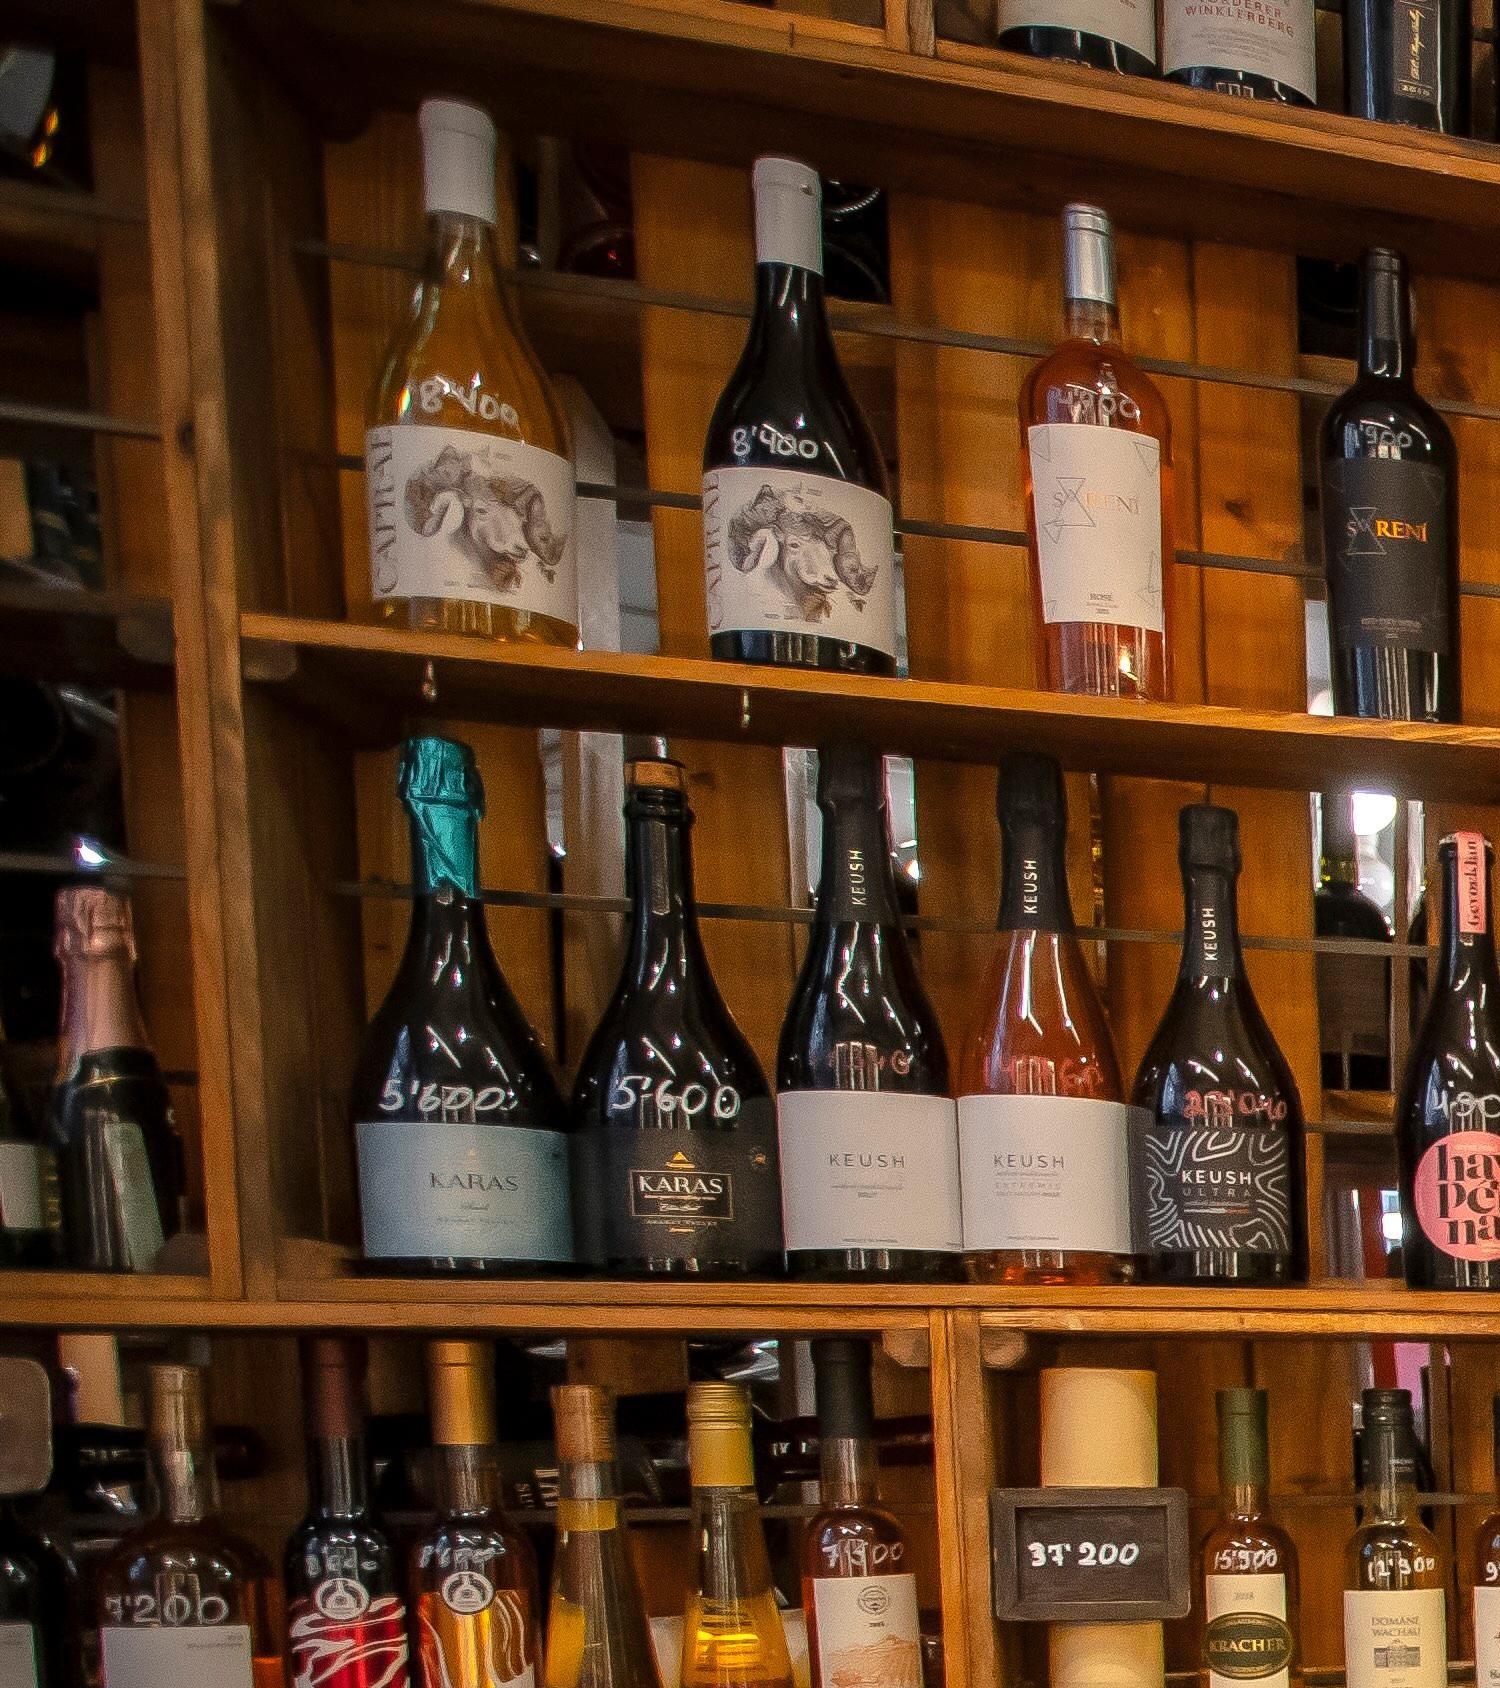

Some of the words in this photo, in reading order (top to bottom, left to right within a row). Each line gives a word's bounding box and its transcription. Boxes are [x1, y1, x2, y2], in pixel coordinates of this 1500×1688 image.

[1185, 6, 1294, 38] WINKLERBERG
[1023, 858, 1038, 914] KEUSH
[1204, 907, 1219, 962] KEUSH
[609, 1076, 741, 1119] 5'600
[829, 1153, 905, 1169] KEUSH
[993, 1153, 1065, 1169] KEUSH
[429, 1172, 519, 1193] KARAS
[639, 1174, 723, 1195] KARAS
[1182, 1169, 1252, 1184] KEUSH
[1208, 1635, 1287, 1655] KRACHER
